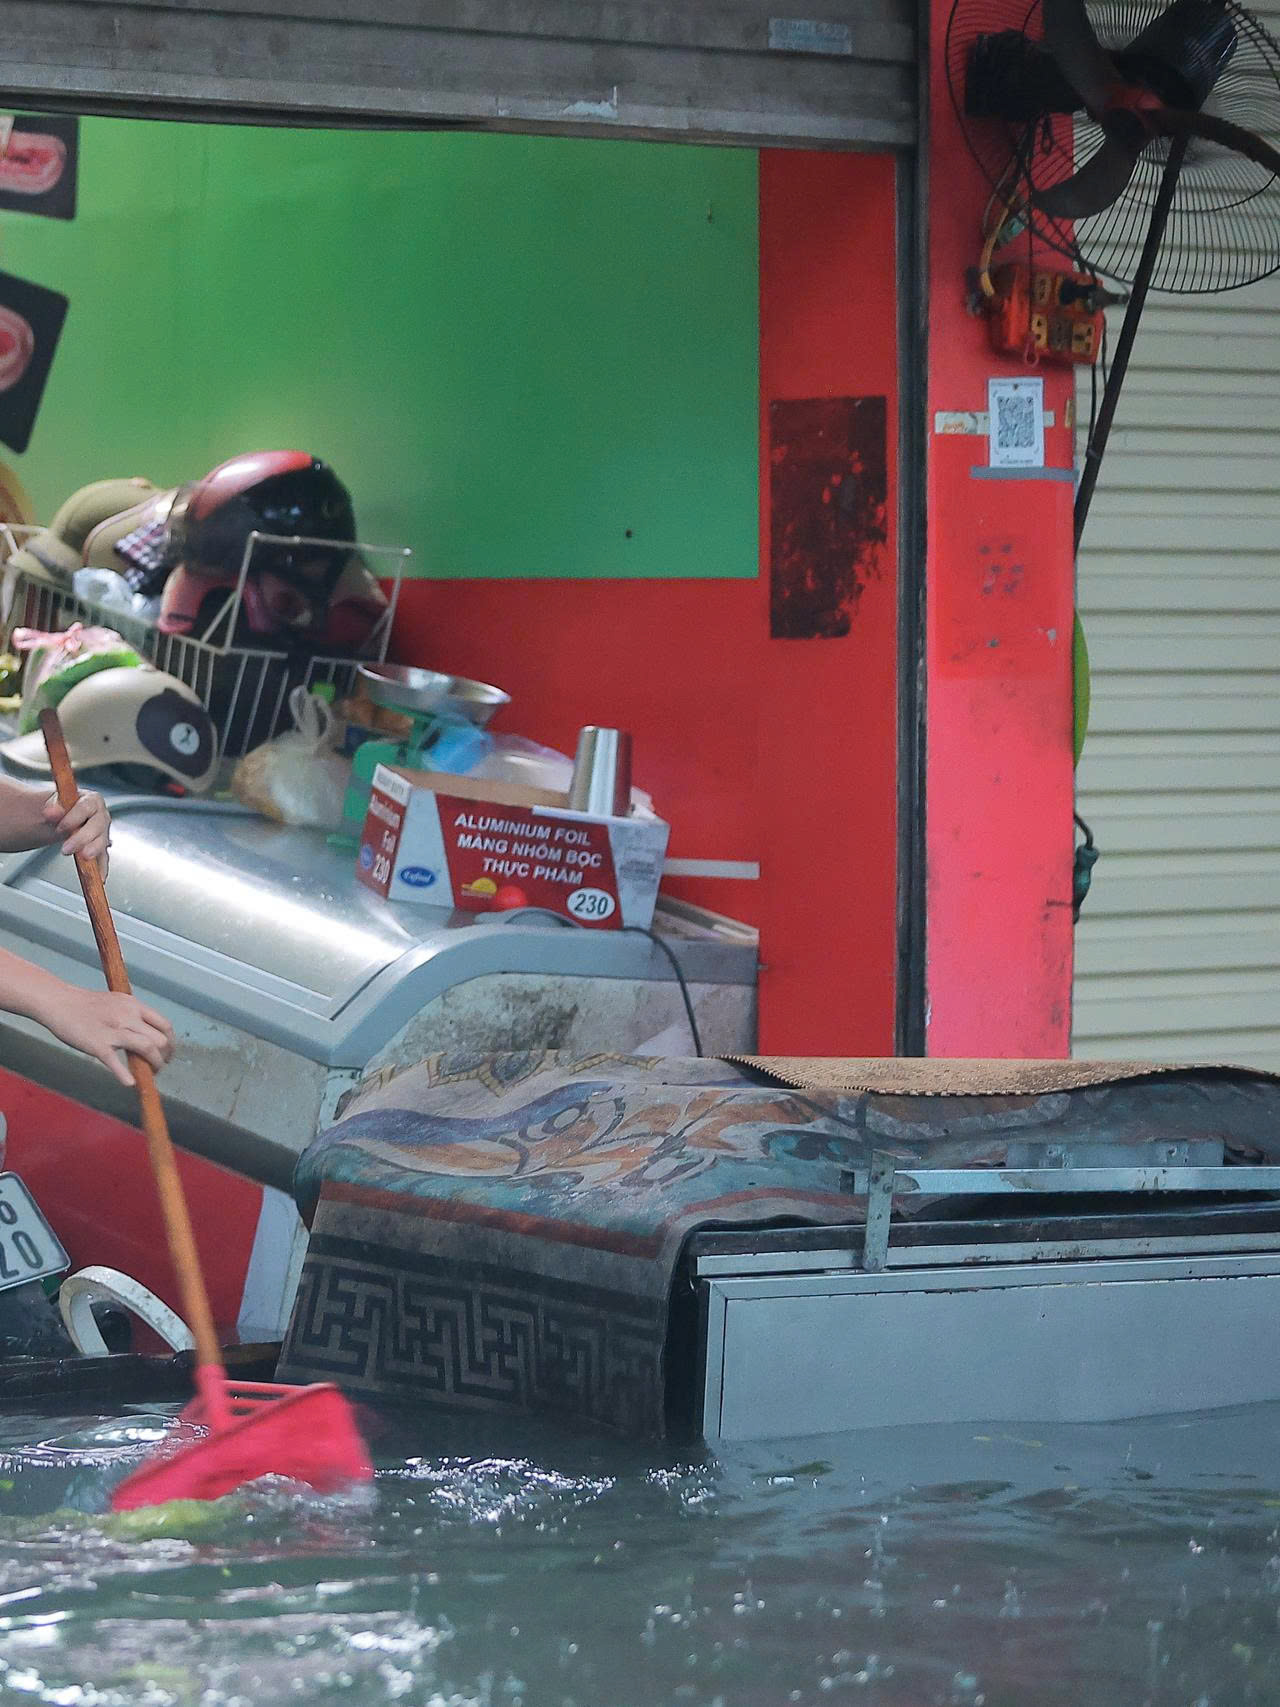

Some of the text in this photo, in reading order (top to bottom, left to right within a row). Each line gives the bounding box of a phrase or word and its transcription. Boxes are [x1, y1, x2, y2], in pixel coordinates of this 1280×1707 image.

[454, 812, 591, 846] ALUMINIUM FOIL
[574, 893, 608, 916] 230
